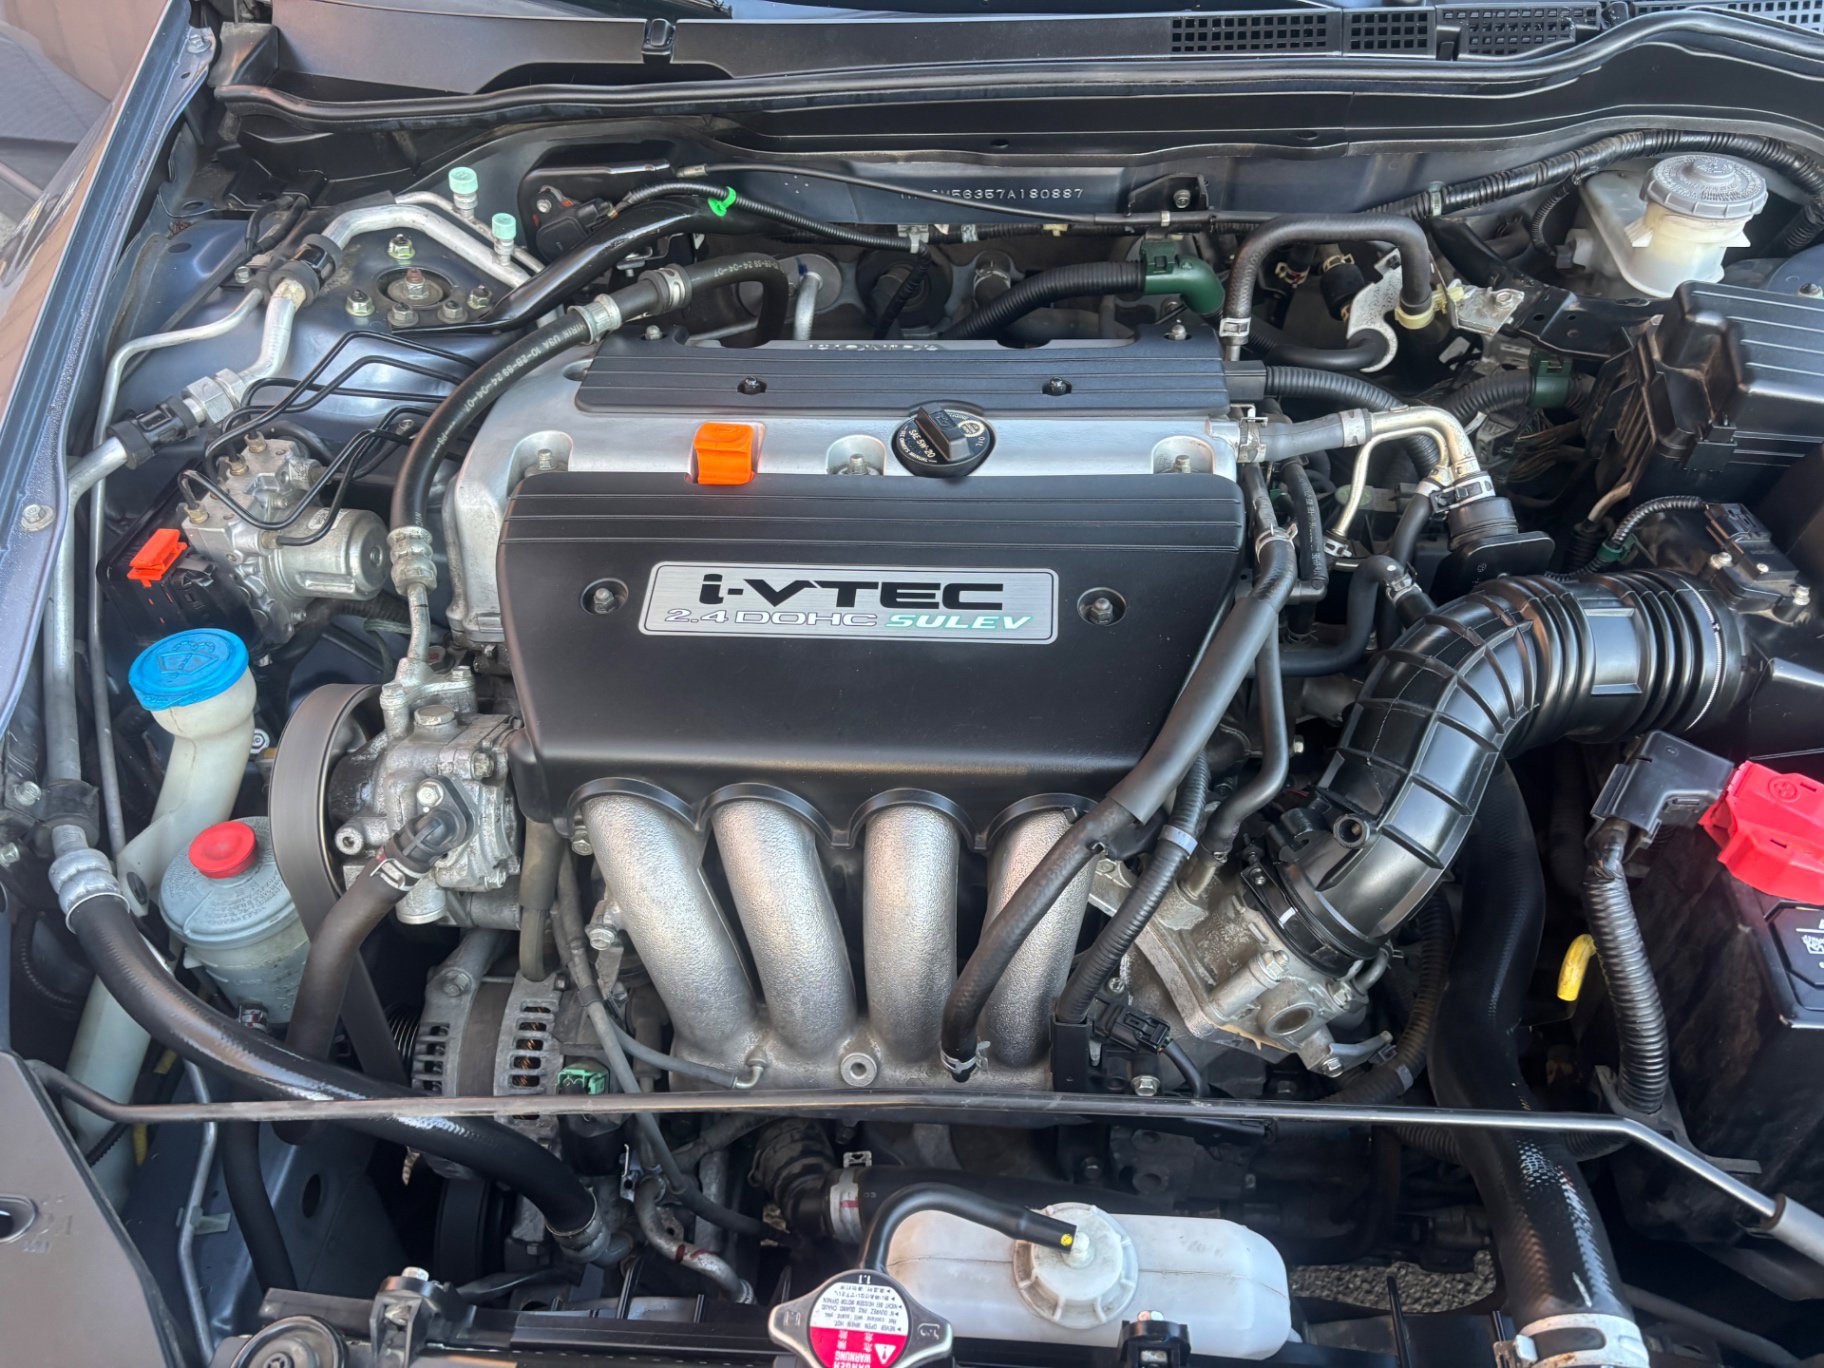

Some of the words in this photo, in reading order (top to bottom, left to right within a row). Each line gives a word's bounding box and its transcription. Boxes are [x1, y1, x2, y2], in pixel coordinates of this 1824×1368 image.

[901, 188, 1084, 200] 56357A180887
[542, 334, 561, 350] USA
[698, 573, 1004, 611] i-VTEC
[884, 614, 1034, 631] SULEV
[858, 1274, 871, 1284] 1.1
[834, 1350, 871, 1363] WARNUNG
